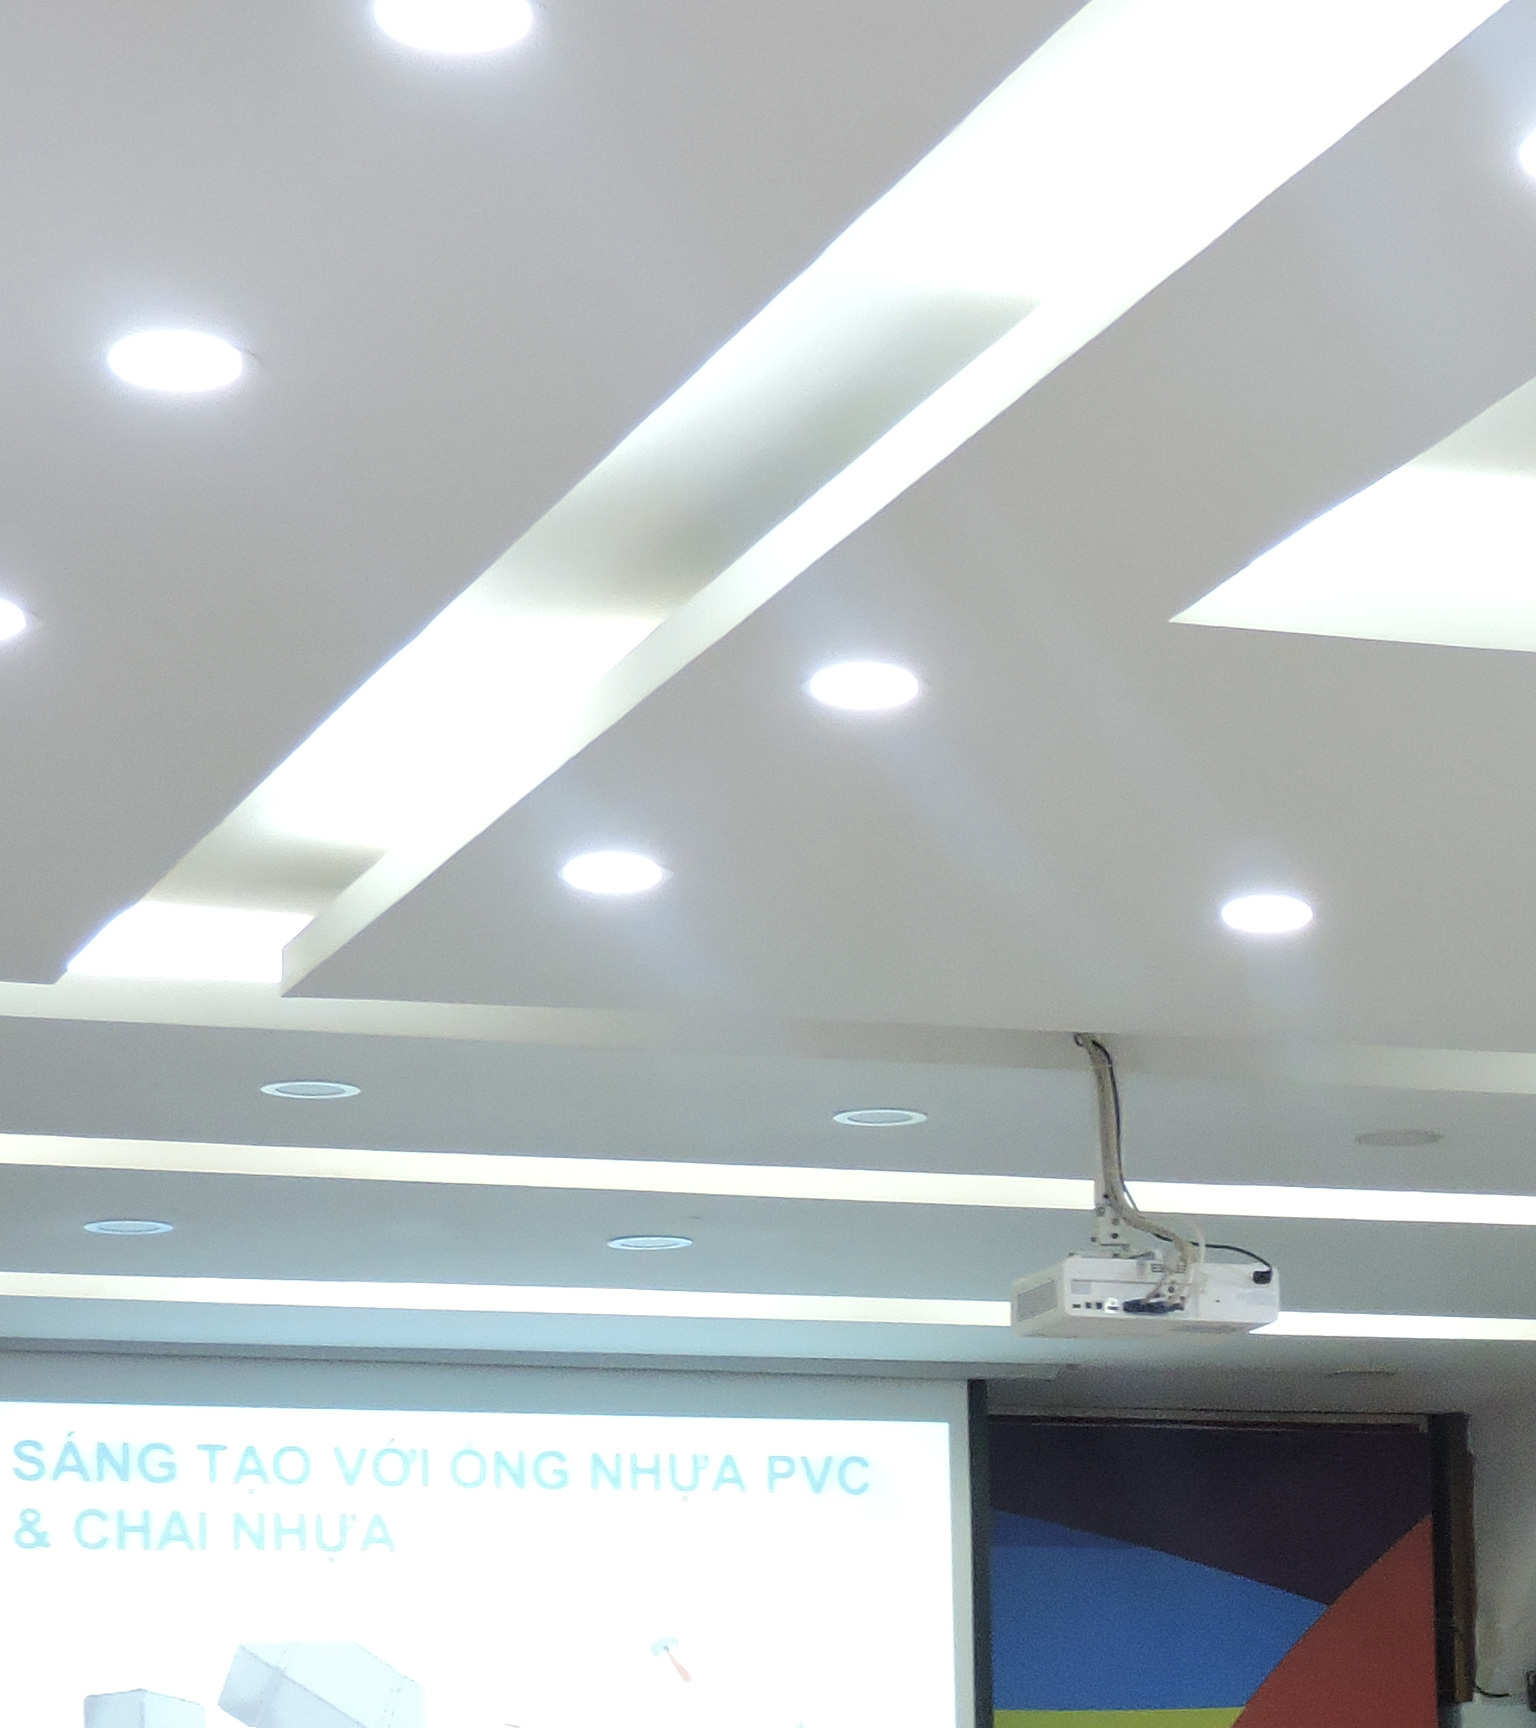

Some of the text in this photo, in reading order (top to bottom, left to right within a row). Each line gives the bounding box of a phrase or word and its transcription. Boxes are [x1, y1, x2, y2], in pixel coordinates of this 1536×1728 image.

[12, 1431, 178, 1485] SÁNG
[197, 1443, 310, 1495] TẠO
[334, 1437, 430, 1488] VỚI
[590, 1452, 747, 1502] NHỰA
[766, 1455, 872, 1496] PVC
[13, 1507, 395, 1562] & CHAI NHỰA
